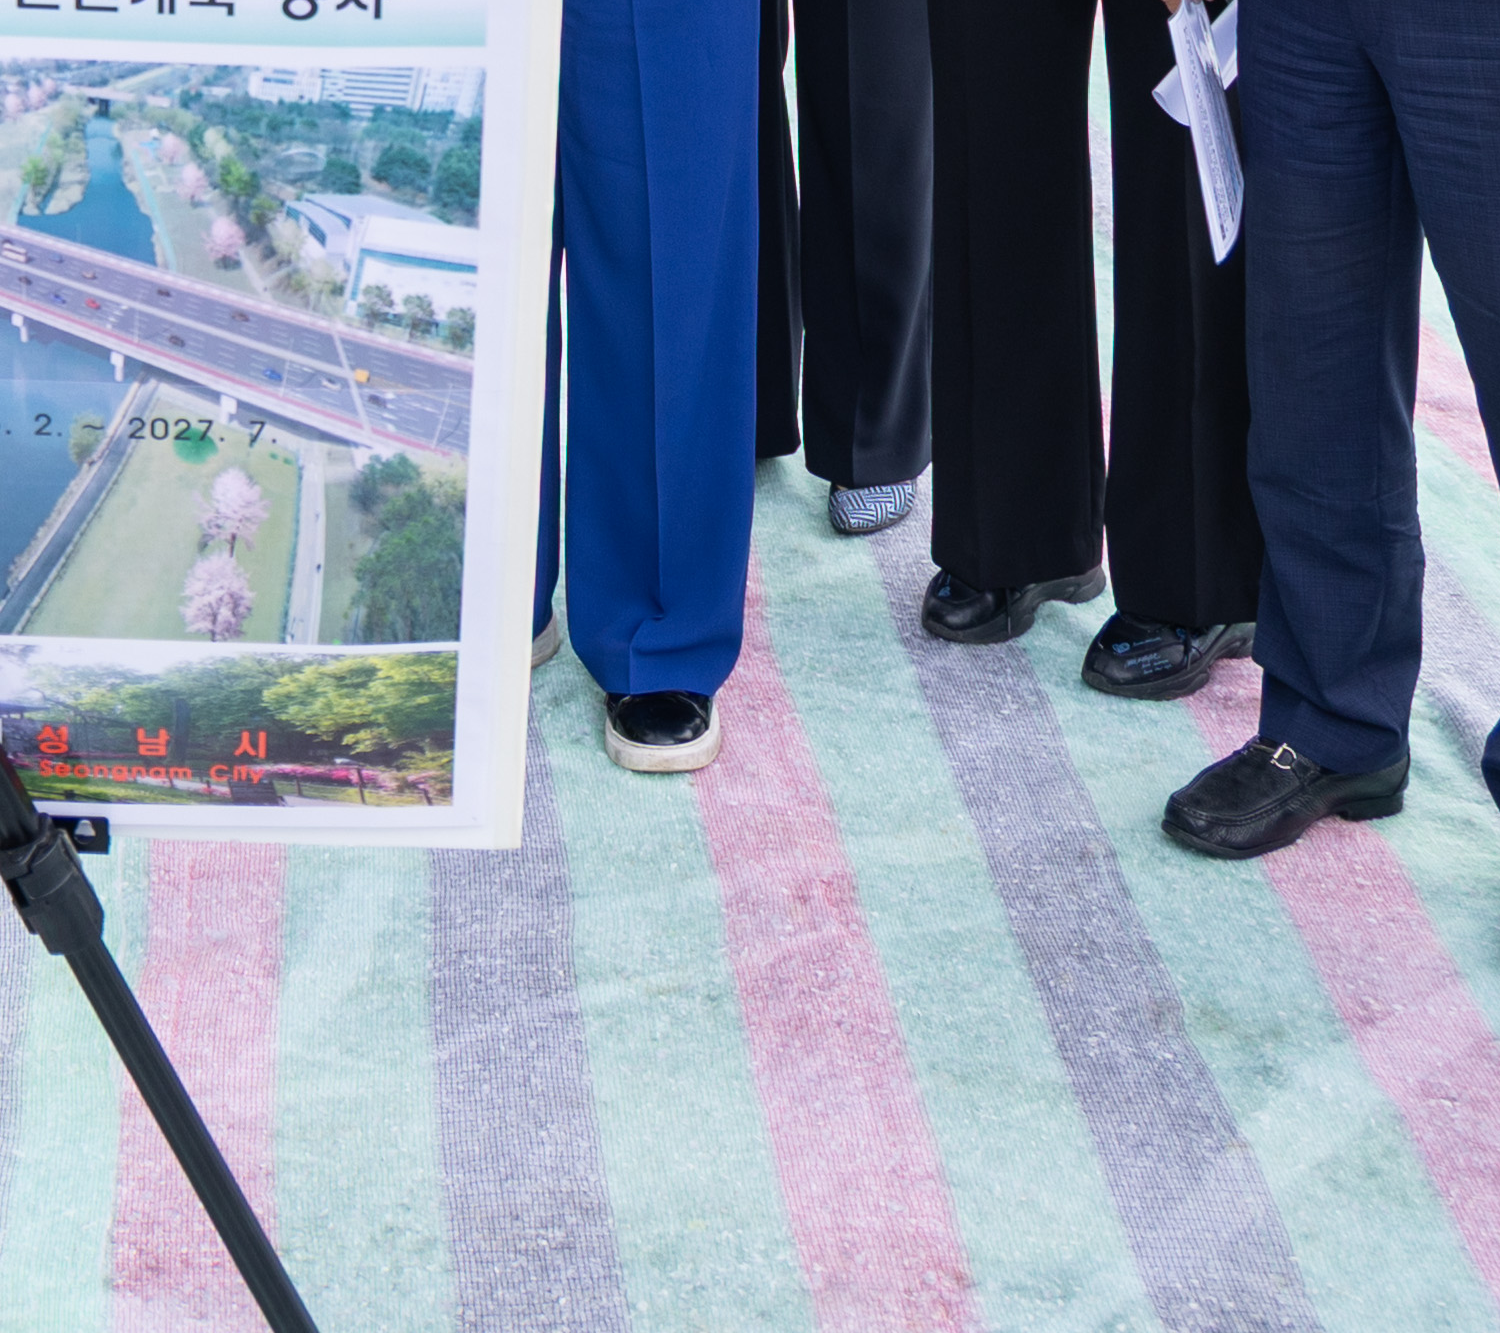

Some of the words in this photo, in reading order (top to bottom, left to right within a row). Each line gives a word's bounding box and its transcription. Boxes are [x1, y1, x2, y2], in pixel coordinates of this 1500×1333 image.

[33, 411, 63, 438] 2.
[128, 415, 225, 443] 2027.
[249, 420, 278, 447] 7.
[39, 759, 193, 782] Seongnam
[209, 764, 266, 784] City
